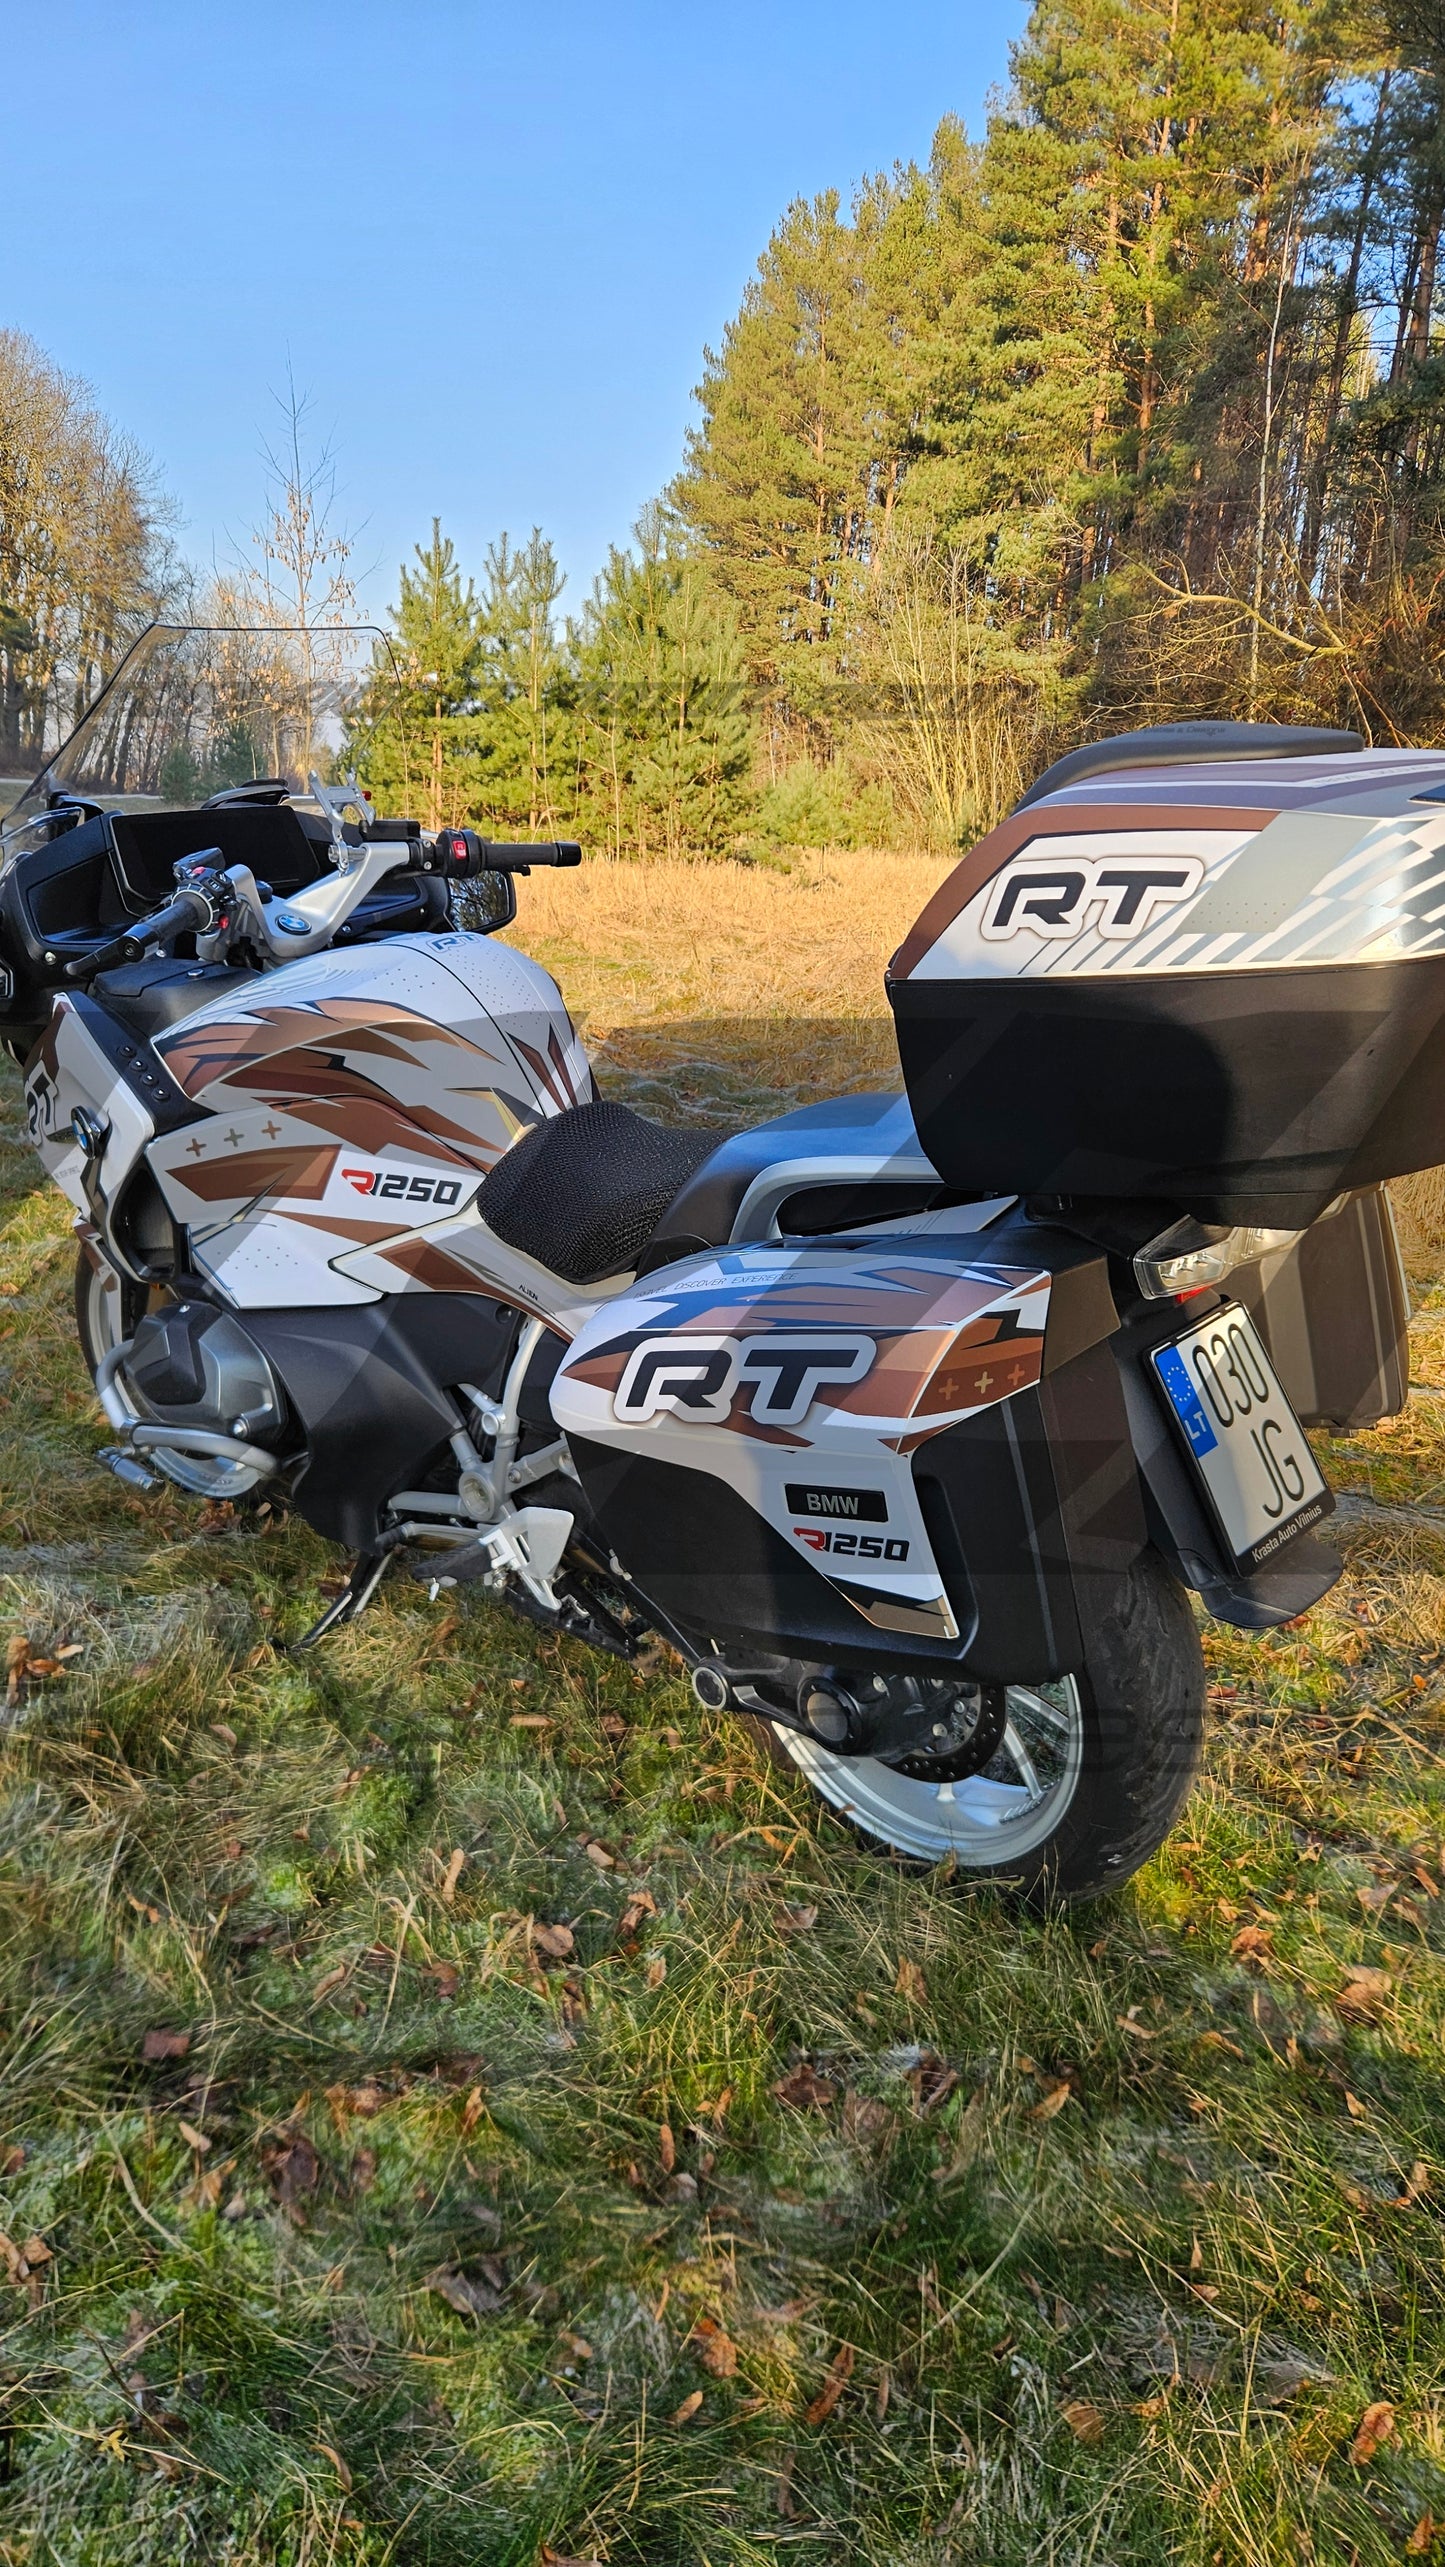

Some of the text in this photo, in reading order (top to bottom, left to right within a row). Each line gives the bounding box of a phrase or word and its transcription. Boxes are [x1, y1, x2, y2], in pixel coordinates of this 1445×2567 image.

[990, 870, 1190, 928] RT
[430, 933, 477, 951] RT
[341, 1168, 463, 1206] R1250
[674, 1278, 727, 1291] DISCOVER
[731, 1272, 799, 1285] EXPERIENCE
[624, 1348, 860, 1411] RT
[1192, 1324, 1269, 1427] 030
[1183, 1410, 1207, 1441] LT
[1250, 1419, 1304, 1519] JG
[806, 1493, 860, 1516] BMW
[792, 1527, 910, 1563] R1250
[1251, 1504, 1323, 1563] Krasta Auto Vilnius
